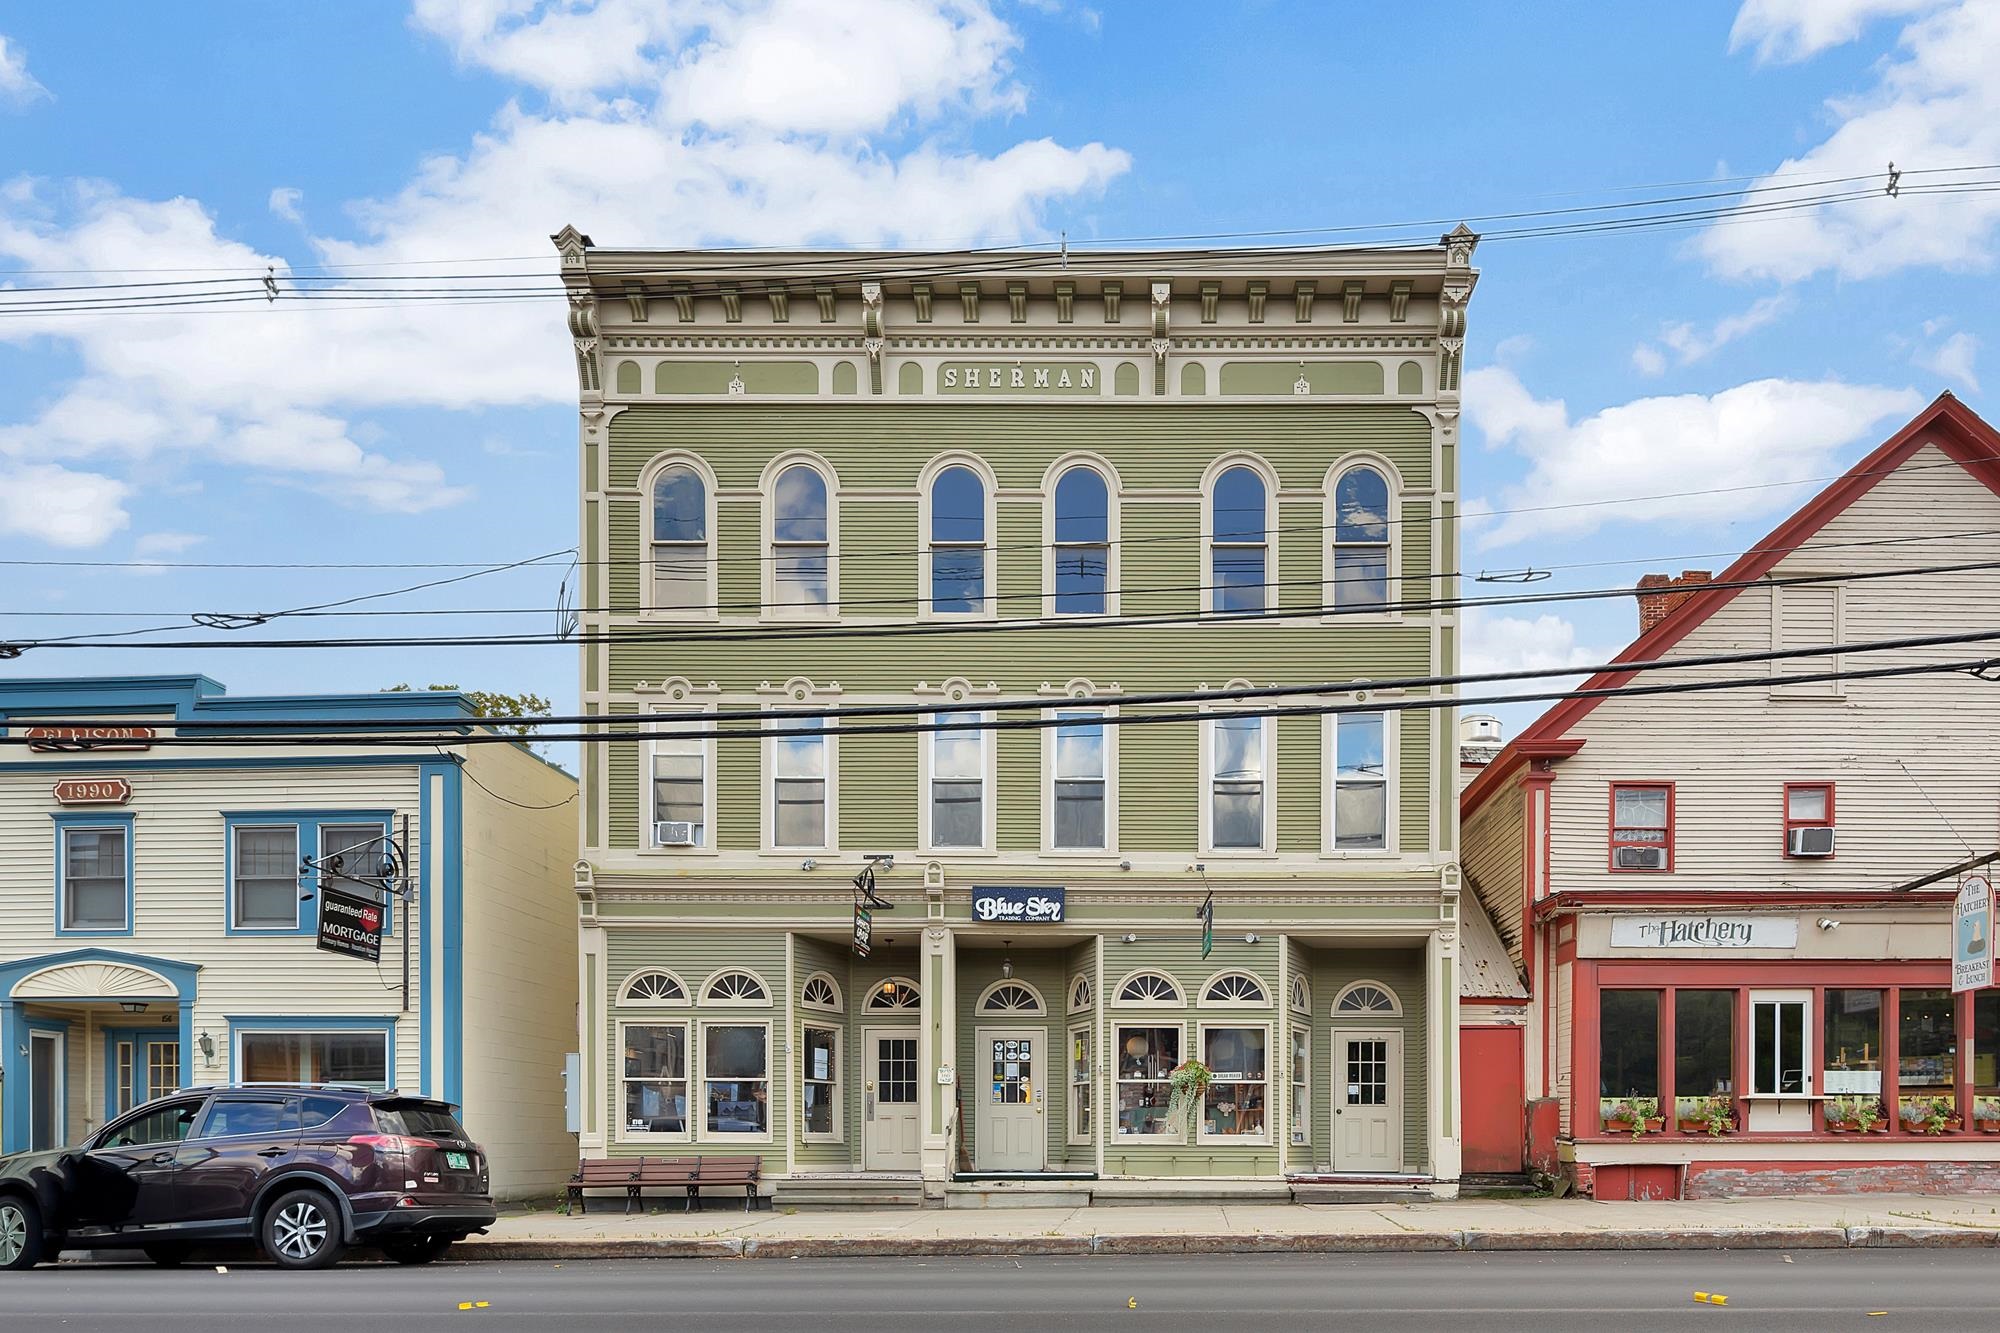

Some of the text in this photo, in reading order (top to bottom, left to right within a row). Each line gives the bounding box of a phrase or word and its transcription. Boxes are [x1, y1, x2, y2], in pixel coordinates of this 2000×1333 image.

[945, 368, 1095, 388] SHERMAN
[67, 784, 113, 799] 1990
[1965, 884, 1981, 897] THE
[325, 900, 378, 922] guaranteed Rate
[975, 897, 1061, 921] Blue Sky
[323, 922, 379, 945] MORTGAGE
[1639, 918, 1753, 946] The Hatchery
[1955, 960, 1989, 975] BREAKFAST
[1966, 973, 1986, 985] LUNCH
